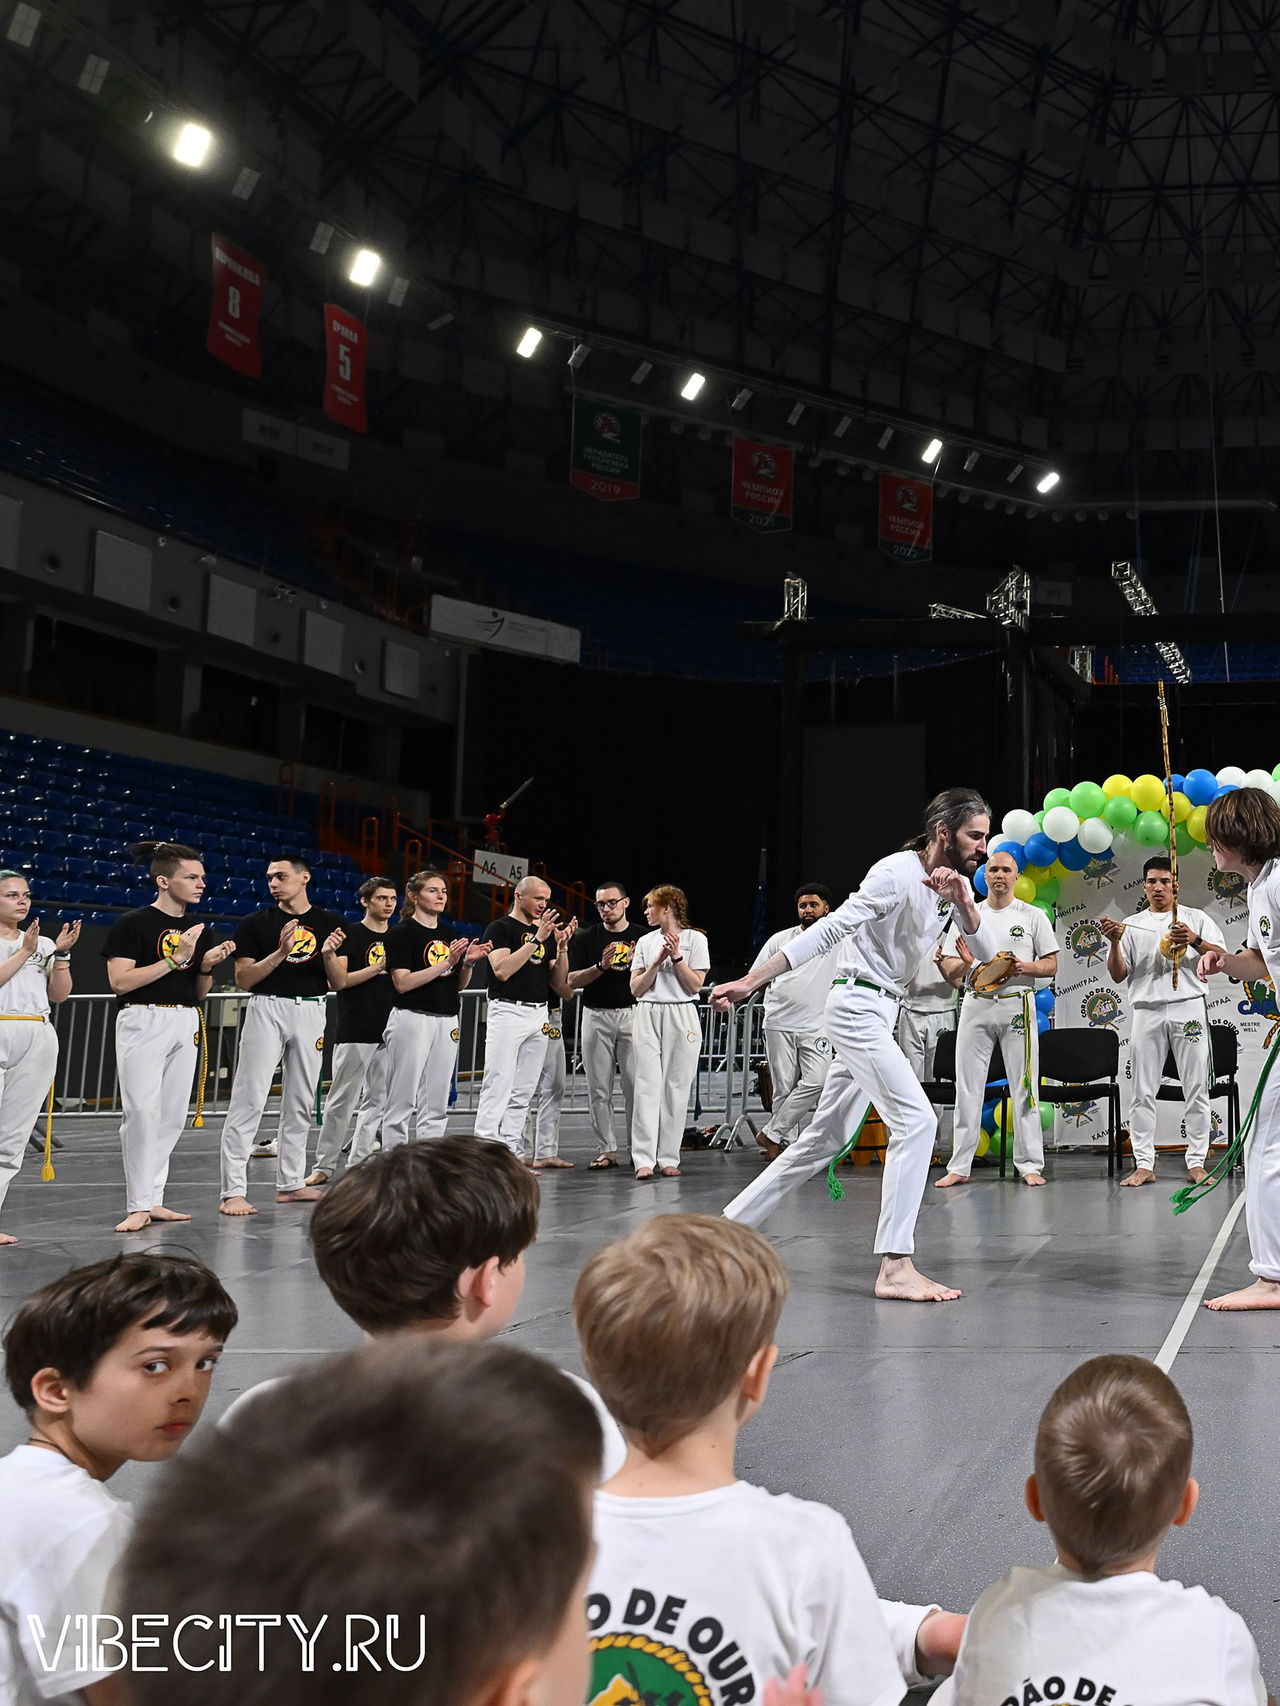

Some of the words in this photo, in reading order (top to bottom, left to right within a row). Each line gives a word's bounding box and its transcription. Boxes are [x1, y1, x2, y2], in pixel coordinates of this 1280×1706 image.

[228, 285, 241, 319] 8
[338, 343, 351, 381] 5
[590, 479, 621, 495] 2019
[740, 480, 784, 497] ЧЕМПИОН
[744, 490, 780, 505] РОССИИ
[748, 513, 776, 528] 2021
[886, 514, 925, 529] ЧЕМПИОН
[890, 524, 921, 537] РОССИИ
[893, 544, 919, 559] 2022
[481, 860, 497, 875] A6
[509, 865, 522, 880] A5
[1055, 903, 1087, 919] НИНГРАД
[1055, 975, 1099, 998] АЛИНИНГРАД
[1106, 988, 1122, 1004] OURO
[1223, 1019, 1240, 1035] OURO
[622, 1588, 687, 1635] DE
[688, 1616, 756, 1706] OUR
[1074, 1677, 1117, 1706] DE
